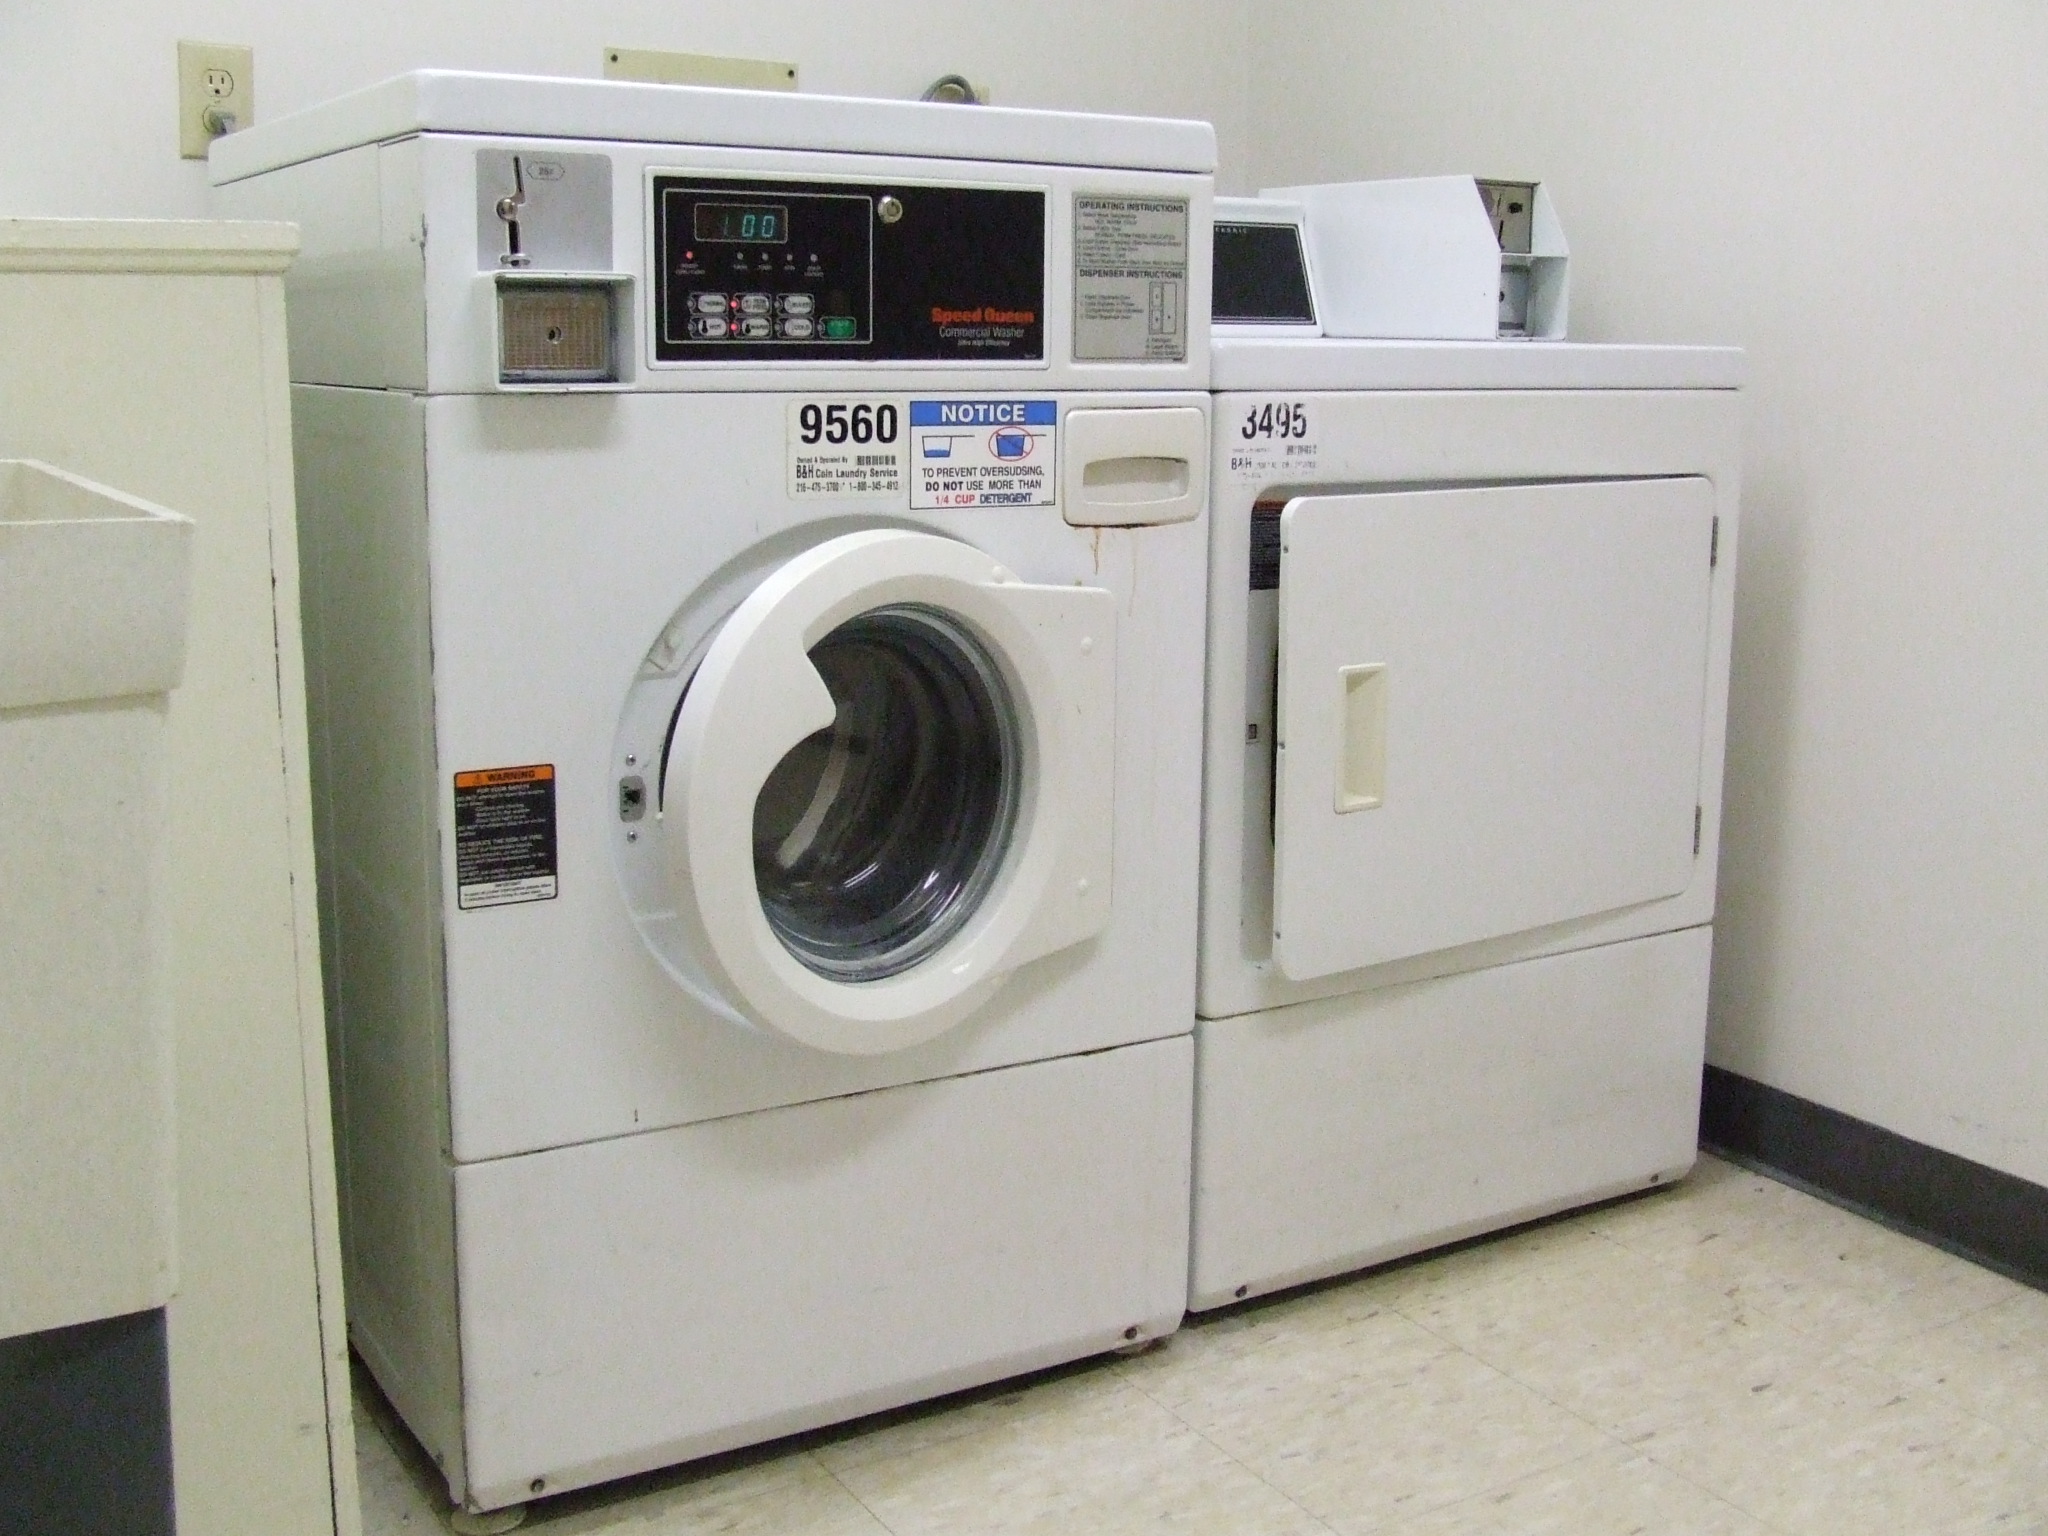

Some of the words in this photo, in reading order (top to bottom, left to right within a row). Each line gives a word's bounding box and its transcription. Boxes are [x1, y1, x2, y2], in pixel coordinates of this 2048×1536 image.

[1079, 201, 1125, 211] OPERATING
[1126, 203, 1184, 214] INSTRUCTIONS
[1079, 269, 1125, 278] DISPENSER
[1126, 270, 1183, 280] INSTRUCTIONS
[931, 307, 982, 327] Speed
[984, 307, 1035, 324] Queen
[938, 326, 991, 338] Commercial
[992, 327, 1025, 339] Washer
[941, 404, 1025, 422] NOTICE
[800, 404, 898, 444] 9560
[1241, 402, 1307, 440] 3495
[796, 464, 814, 479] B&H
[815, 469, 833, 478] Coin
[836, 468, 868, 479] Laundry
[869, 468, 899, 478] Service
[922, 468, 935, 478] TO
[936, 467, 978, 477] PREVENT
[979, 466, 1045, 477] OVERSUDSING,
[925, 482, 940, 492] DO
[943, 481, 964, 491] NOT
[966, 481, 984, 491] USE
[988, 480, 1014, 490] MORE
[1018, 480, 1042, 490] THAN
[935, 495, 949, 504] 1/4
[954, 494, 976, 504] CUP
[979, 493, 1032, 504] DETERGENT
[487, 770, 535, 782] WARNING
